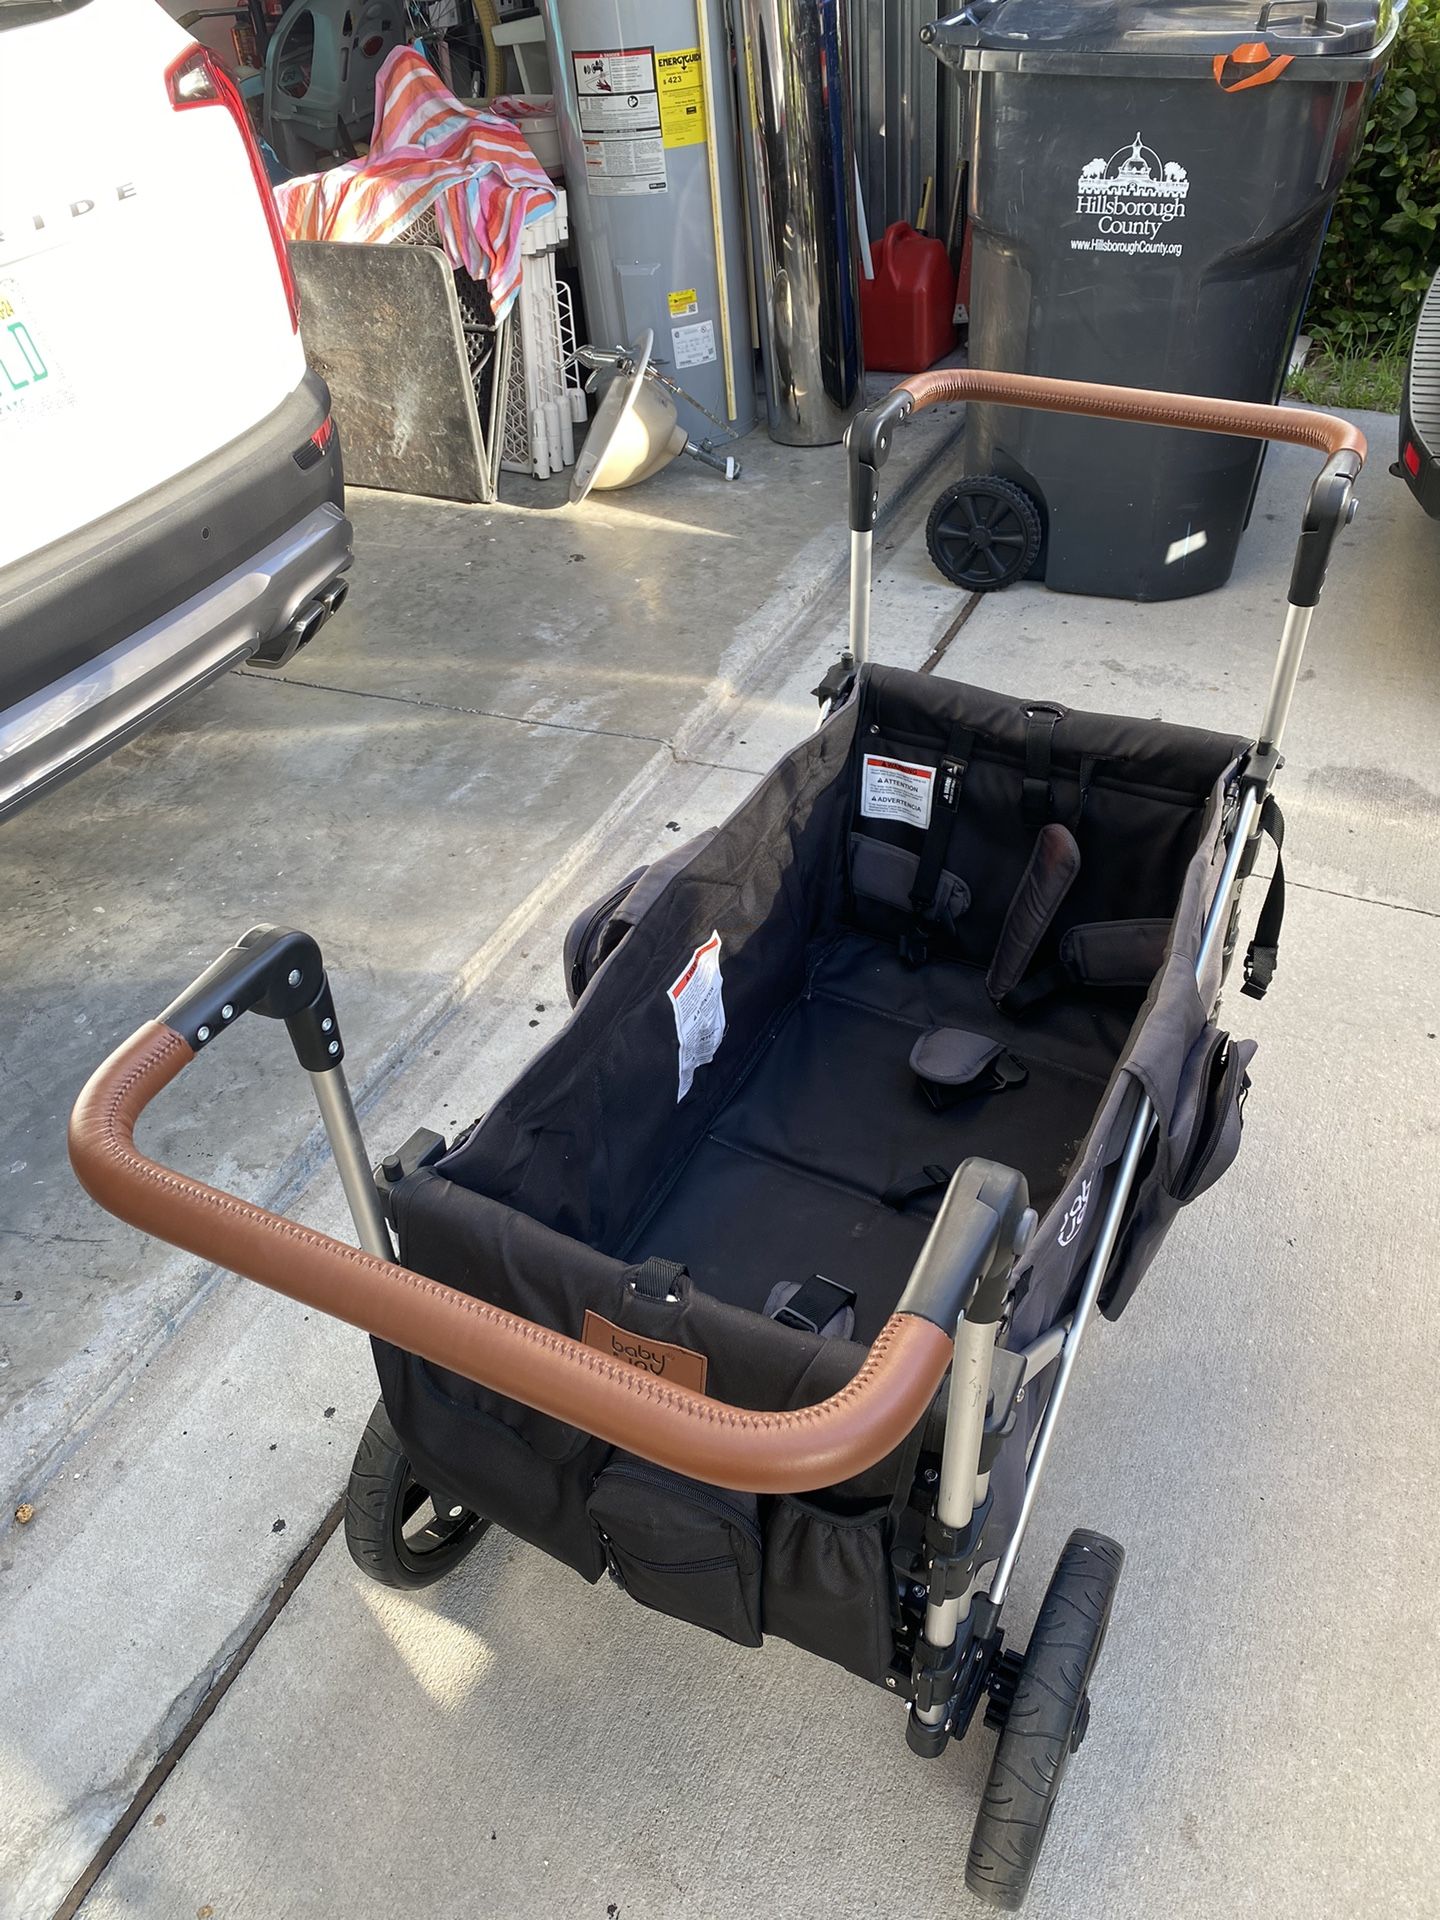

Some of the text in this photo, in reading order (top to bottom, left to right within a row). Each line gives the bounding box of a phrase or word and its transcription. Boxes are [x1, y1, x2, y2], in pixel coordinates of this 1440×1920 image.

[667, 76, 682, 84] 423
[0, 182, 137, 243] IDE
[1076, 195, 1186, 222] Hillsborough
[1098, 216, 1162, 240] County
[1070, 238, 1183, 257] www.HillsboroughCounty.org
[883, 777, 919, 793] ATTENTION
[877, 796, 922, 812] ADVERTENCIA
[611, 1335, 665, 1368] baby
